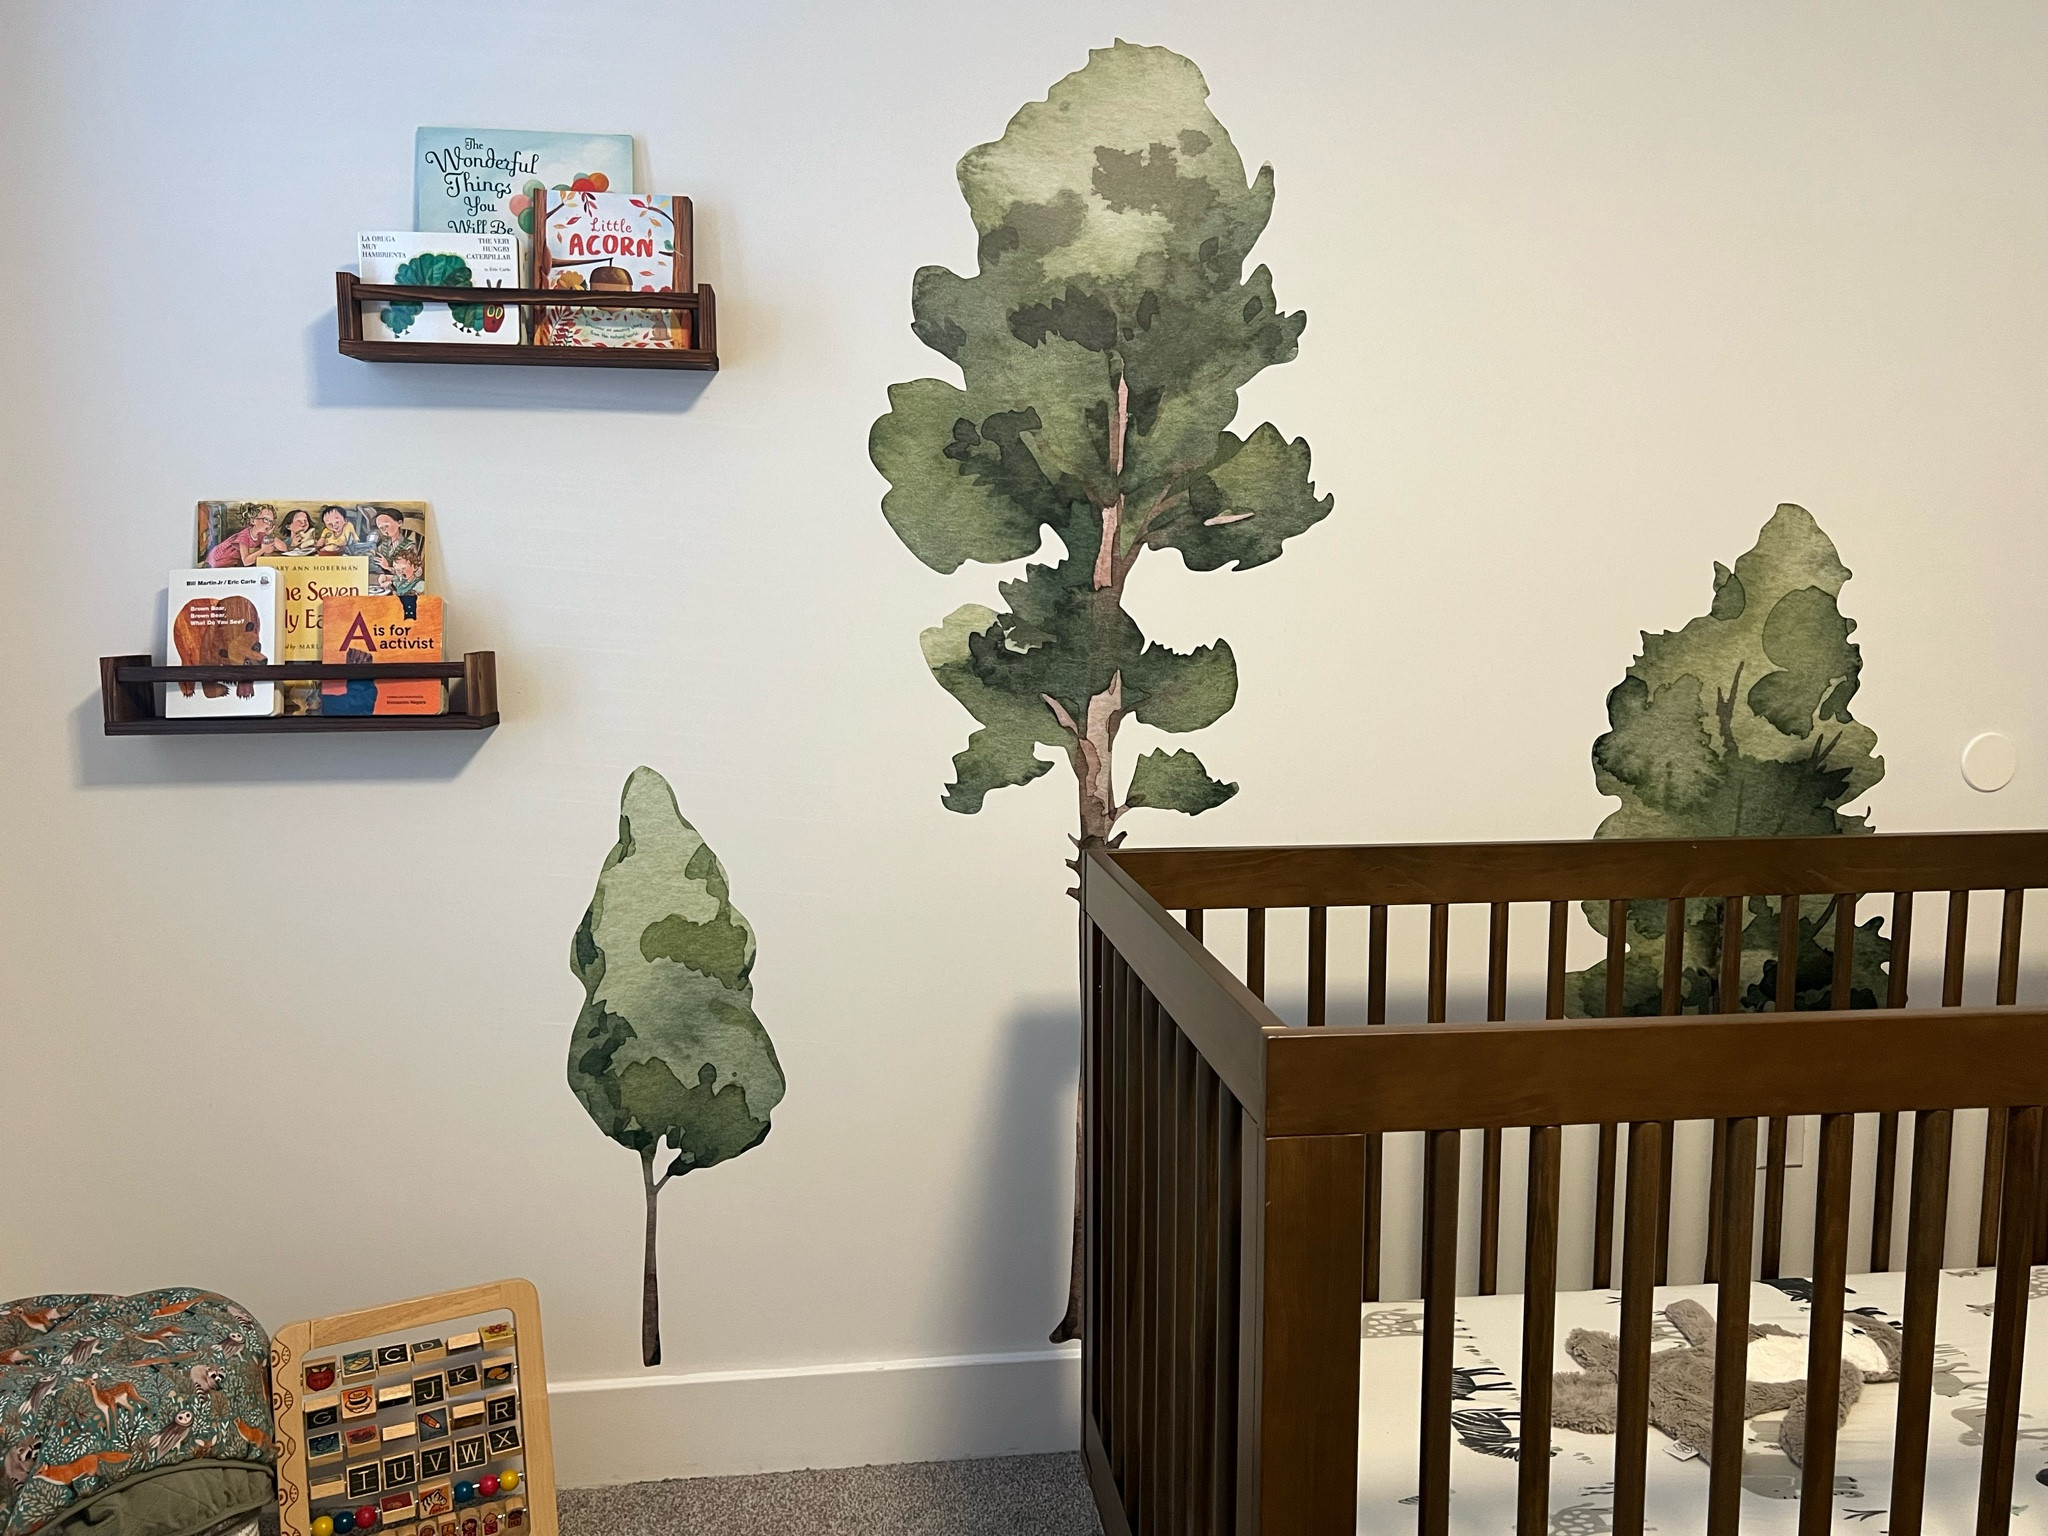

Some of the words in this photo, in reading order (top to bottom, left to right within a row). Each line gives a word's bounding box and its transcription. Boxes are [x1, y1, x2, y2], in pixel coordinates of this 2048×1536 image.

[465, 137, 484, 150] The
[425, 146, 540, 177] Wonderful
[444, 171, 512, 199] Things
[464, 196, 497, 217] You
[447, 219, 487, 234] Will
[490, 219, 514, 235] Be
[590, 217, 633, 233] Little
[569, 234, 652, 257] ACORN
[307, 581, 359, 602] Seven
[339, 611, 378, 653] A
[373, 625, 386, 636] is
[389, 624, 411, 635] for
[380, 637, 434, 650] activist
[385, 1348, 402, 1361] C
[420, 1342, 434, 1350] D
[455, 1369, 468, 1383] K
[423, 1381, 435, 1400] J
[313, 1411, 331, 1425] G
[494, 1401, 509, 1420] R
[393, 1461, 406, 1481] U
[428, 1453, 443, 1471] V
[461, 1441, 479, 1462] W
[495, 1430, 512, 1448] X
